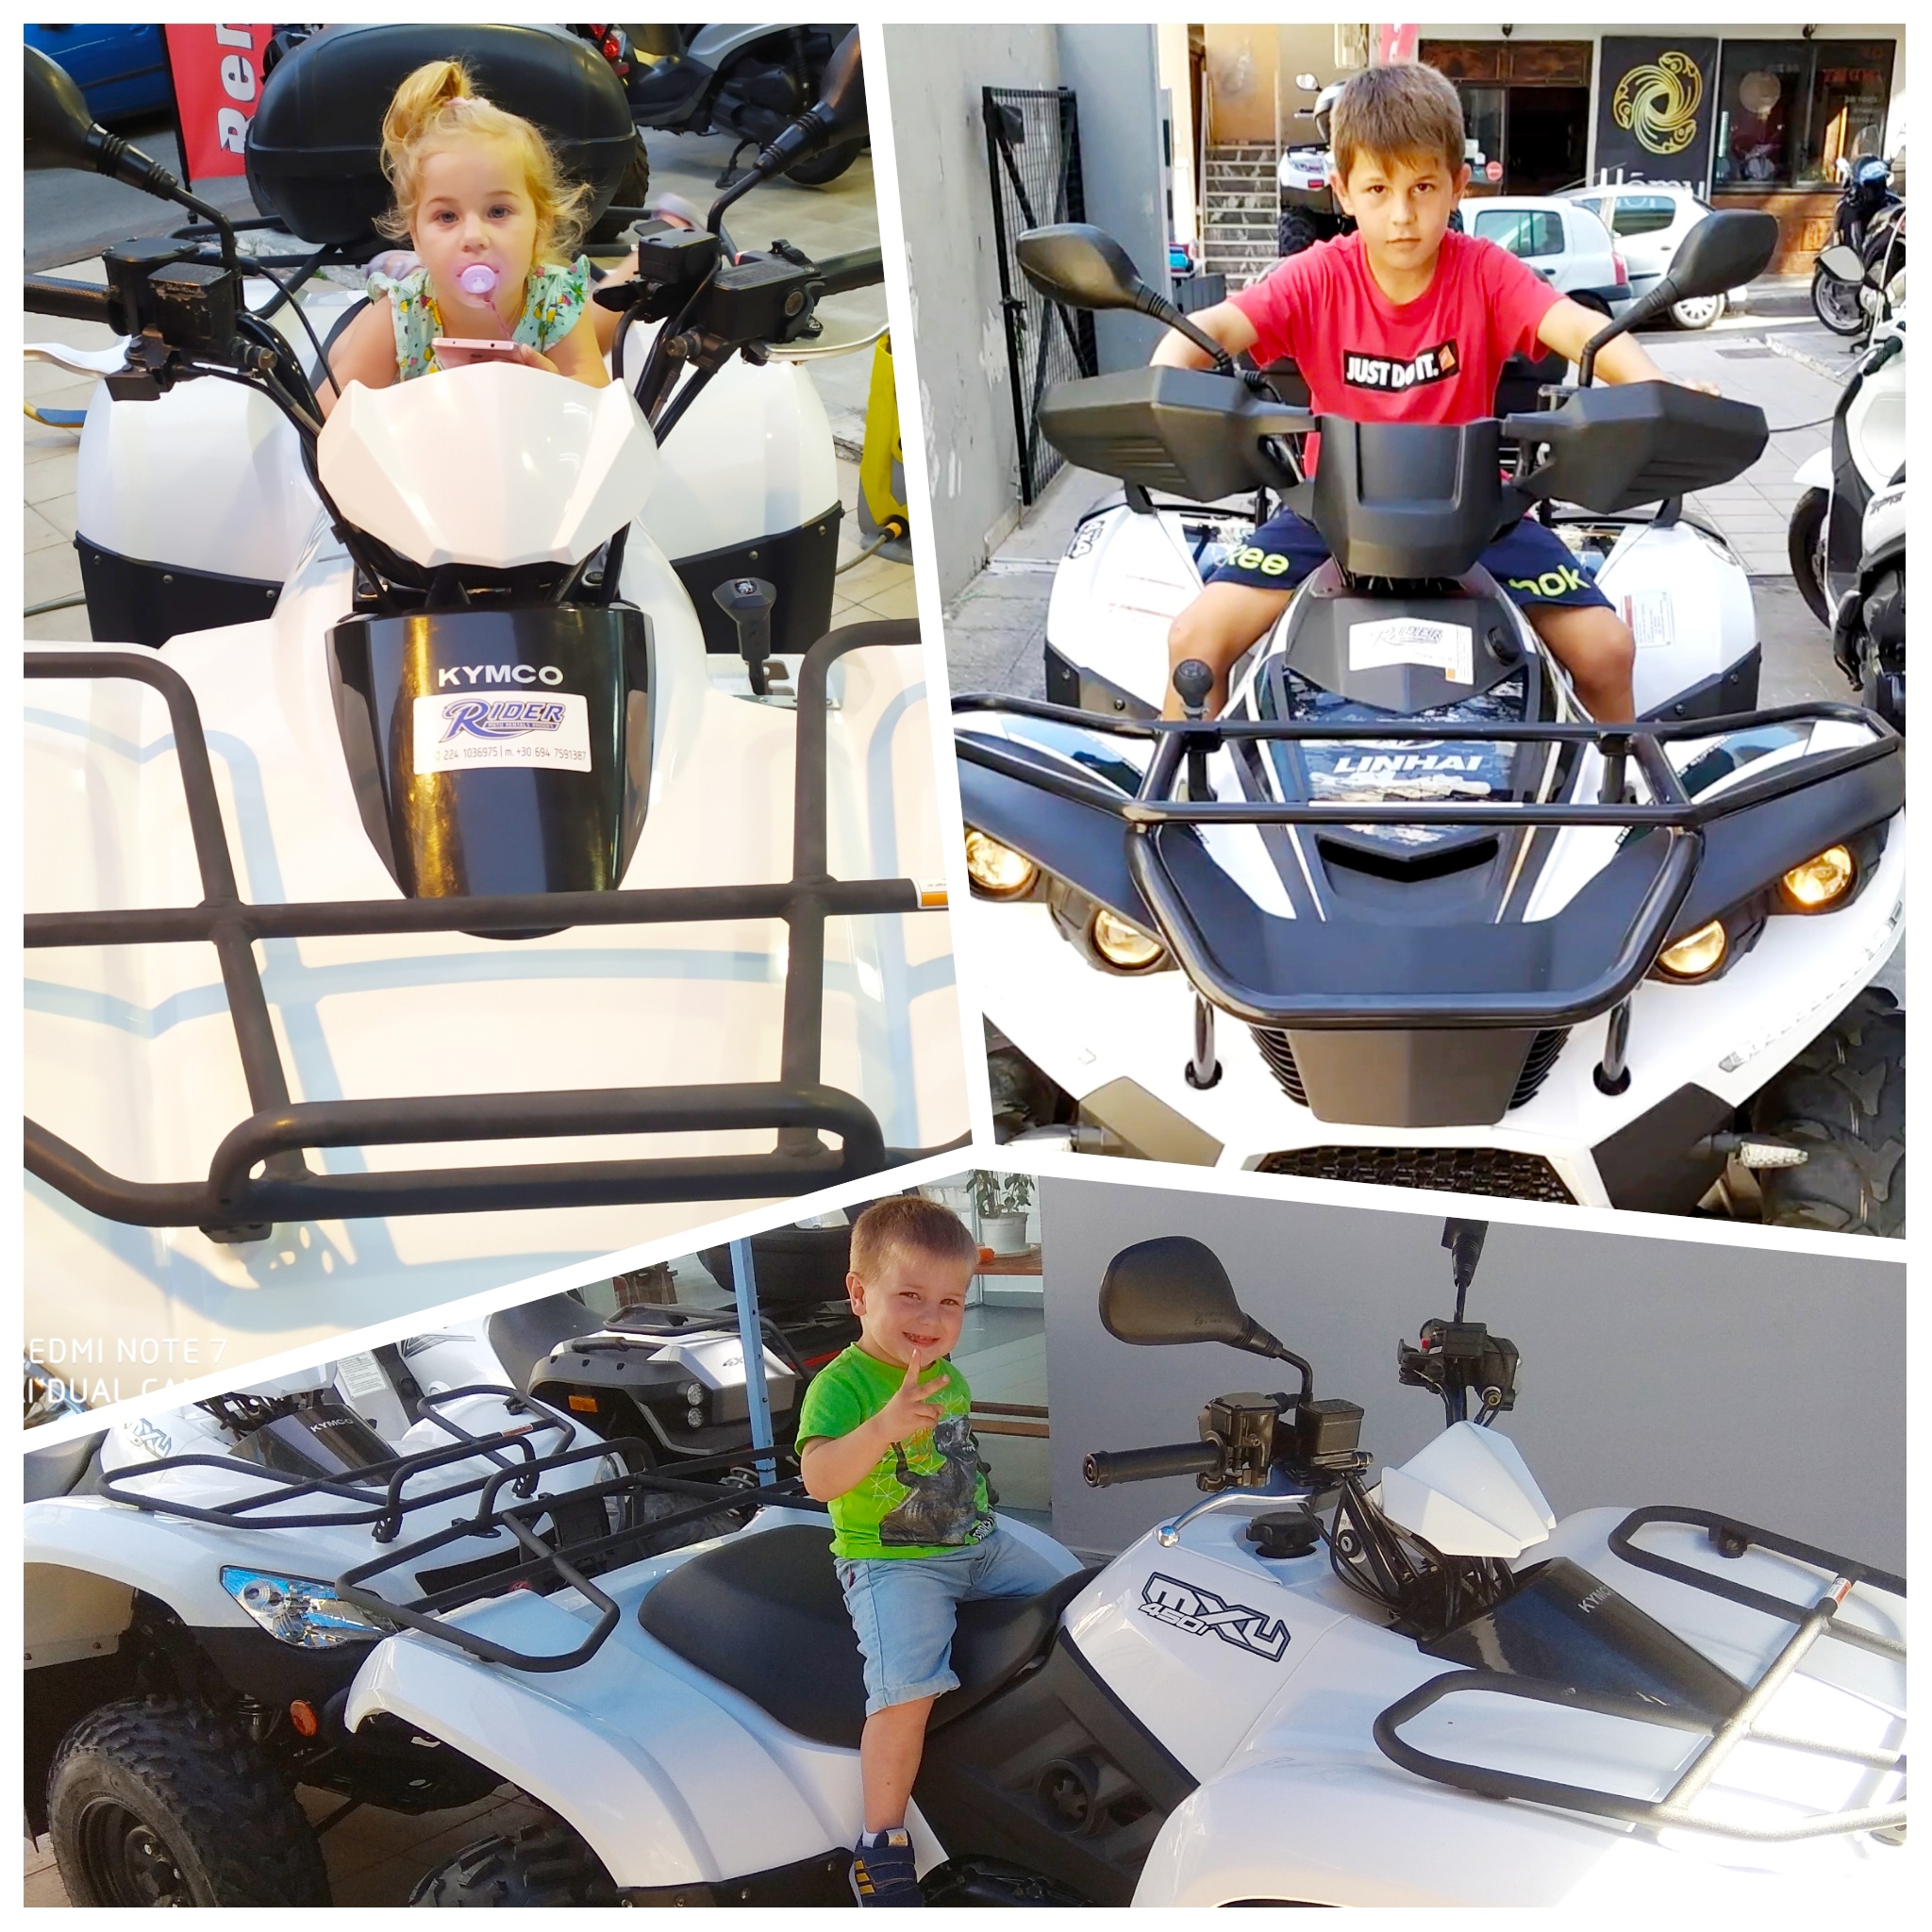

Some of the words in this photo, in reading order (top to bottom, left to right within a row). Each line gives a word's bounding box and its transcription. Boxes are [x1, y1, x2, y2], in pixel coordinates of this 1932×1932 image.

[1346, 357, 1391, 386] JUST
[1391, 363, 1416, 388] DO
[1415, 352, 1439, 381] IT.
[438, 664, 564, 687] KYMCO
[439, 698, 566, 743] RIDER
[443, 749, 459, 761] 224
[463, 746, 498, 758] 1036975
[516, 746, 532, 758] +30
[535, 747, 550, 758] 694
[554, 748, 587, 761] 7591387
[1333, 755, 1484, 774] LINHAI
[309, 1418, 355, 1433] KYMCO
